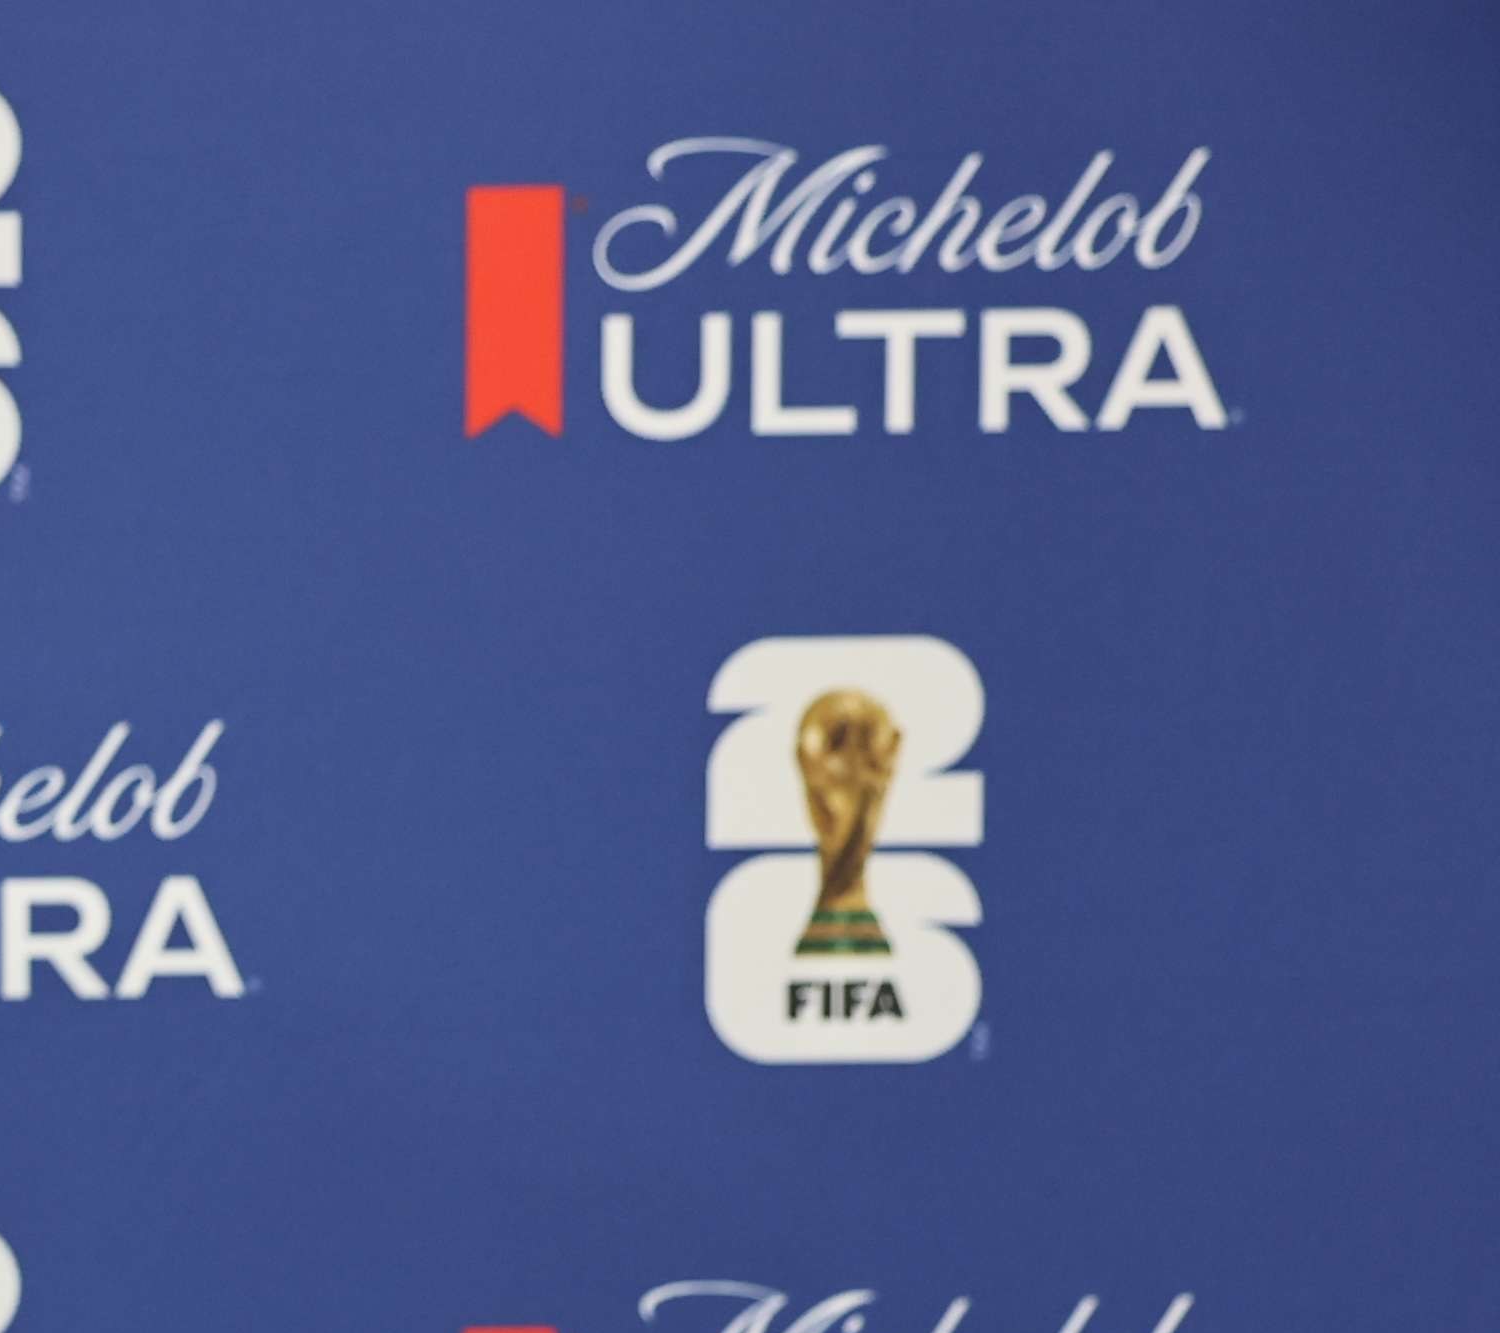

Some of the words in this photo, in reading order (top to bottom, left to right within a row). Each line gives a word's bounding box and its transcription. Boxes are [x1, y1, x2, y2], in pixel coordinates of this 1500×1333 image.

[594, 140, 1207, 290] Michelob
[602, 307, 1225, 439] ULTRA
[786, 979, 905, 1021] FIFA
